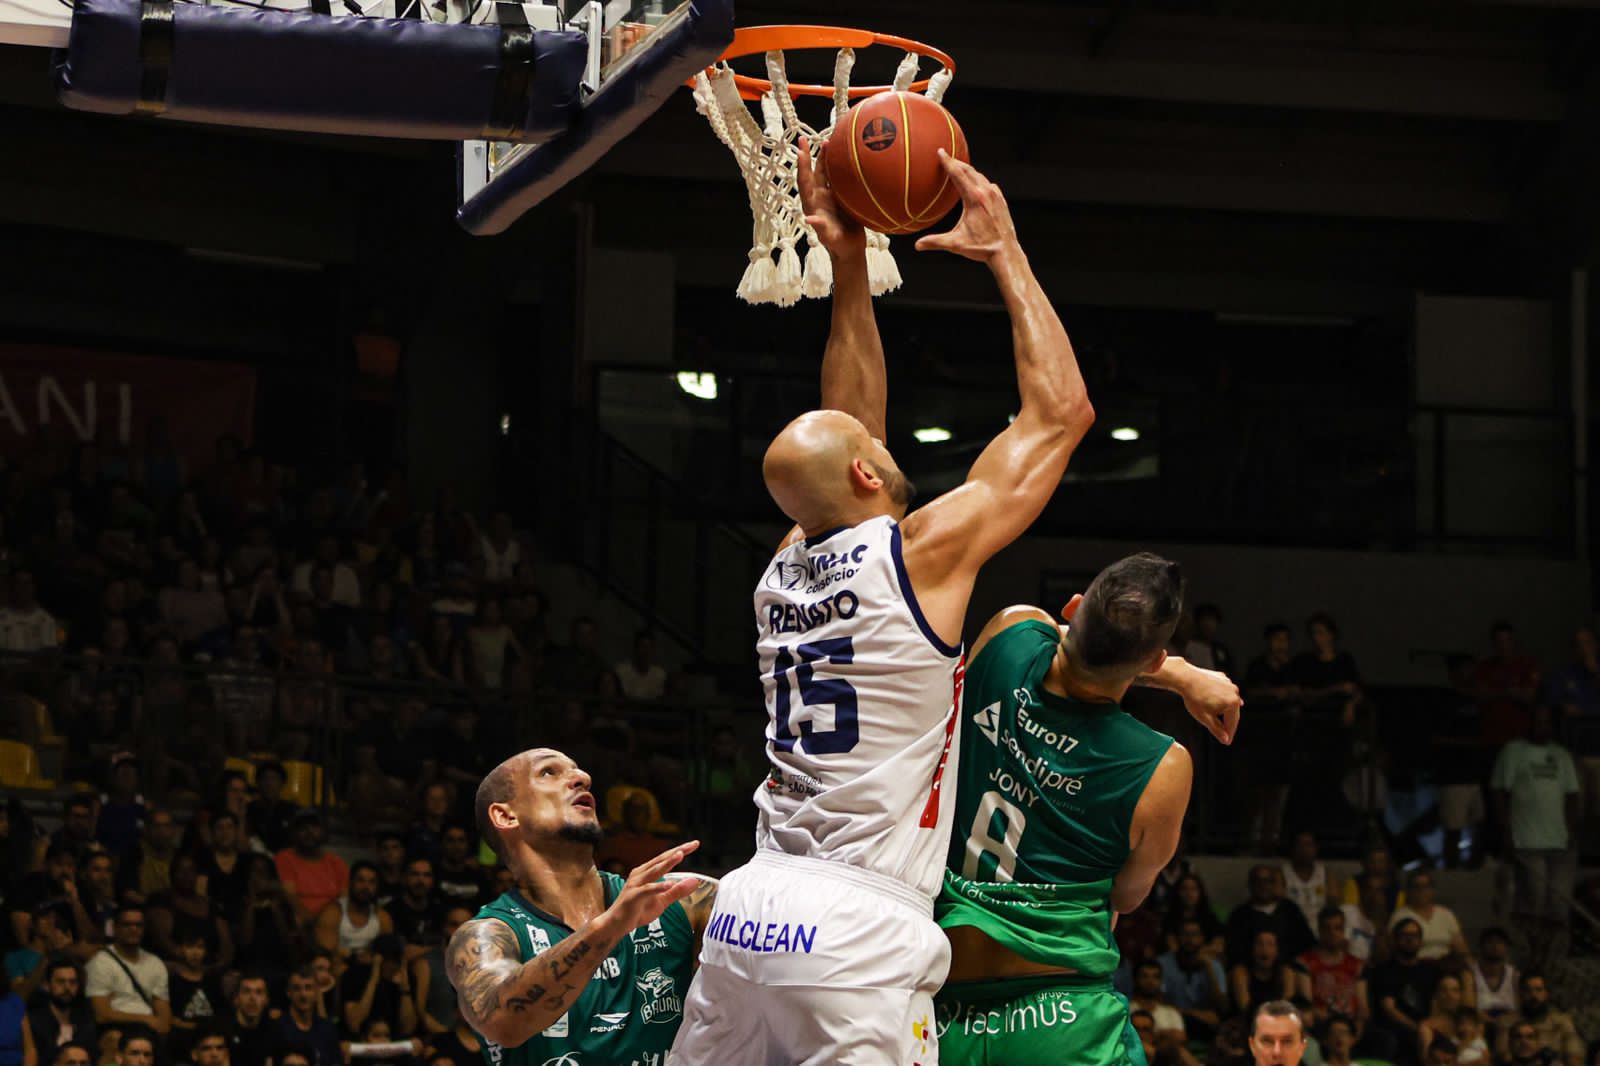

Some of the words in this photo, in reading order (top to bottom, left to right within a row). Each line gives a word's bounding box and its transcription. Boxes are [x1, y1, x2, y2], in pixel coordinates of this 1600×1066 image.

[769, 589, 859, 635] RENATO
[772, 636, 860, 756] 15
[1017, 706, 1080, 754] Euro17
[989, 767, 1040, 808] JONY
[962, 791, 1026, 882] 8
[707, 911, 817, 954] MILCLEAN
[590, 1023, 627, 1033] PENALT
[642, 998, 681, 1021] BAURU
[964, 1000, 1077, 1036] facimus
